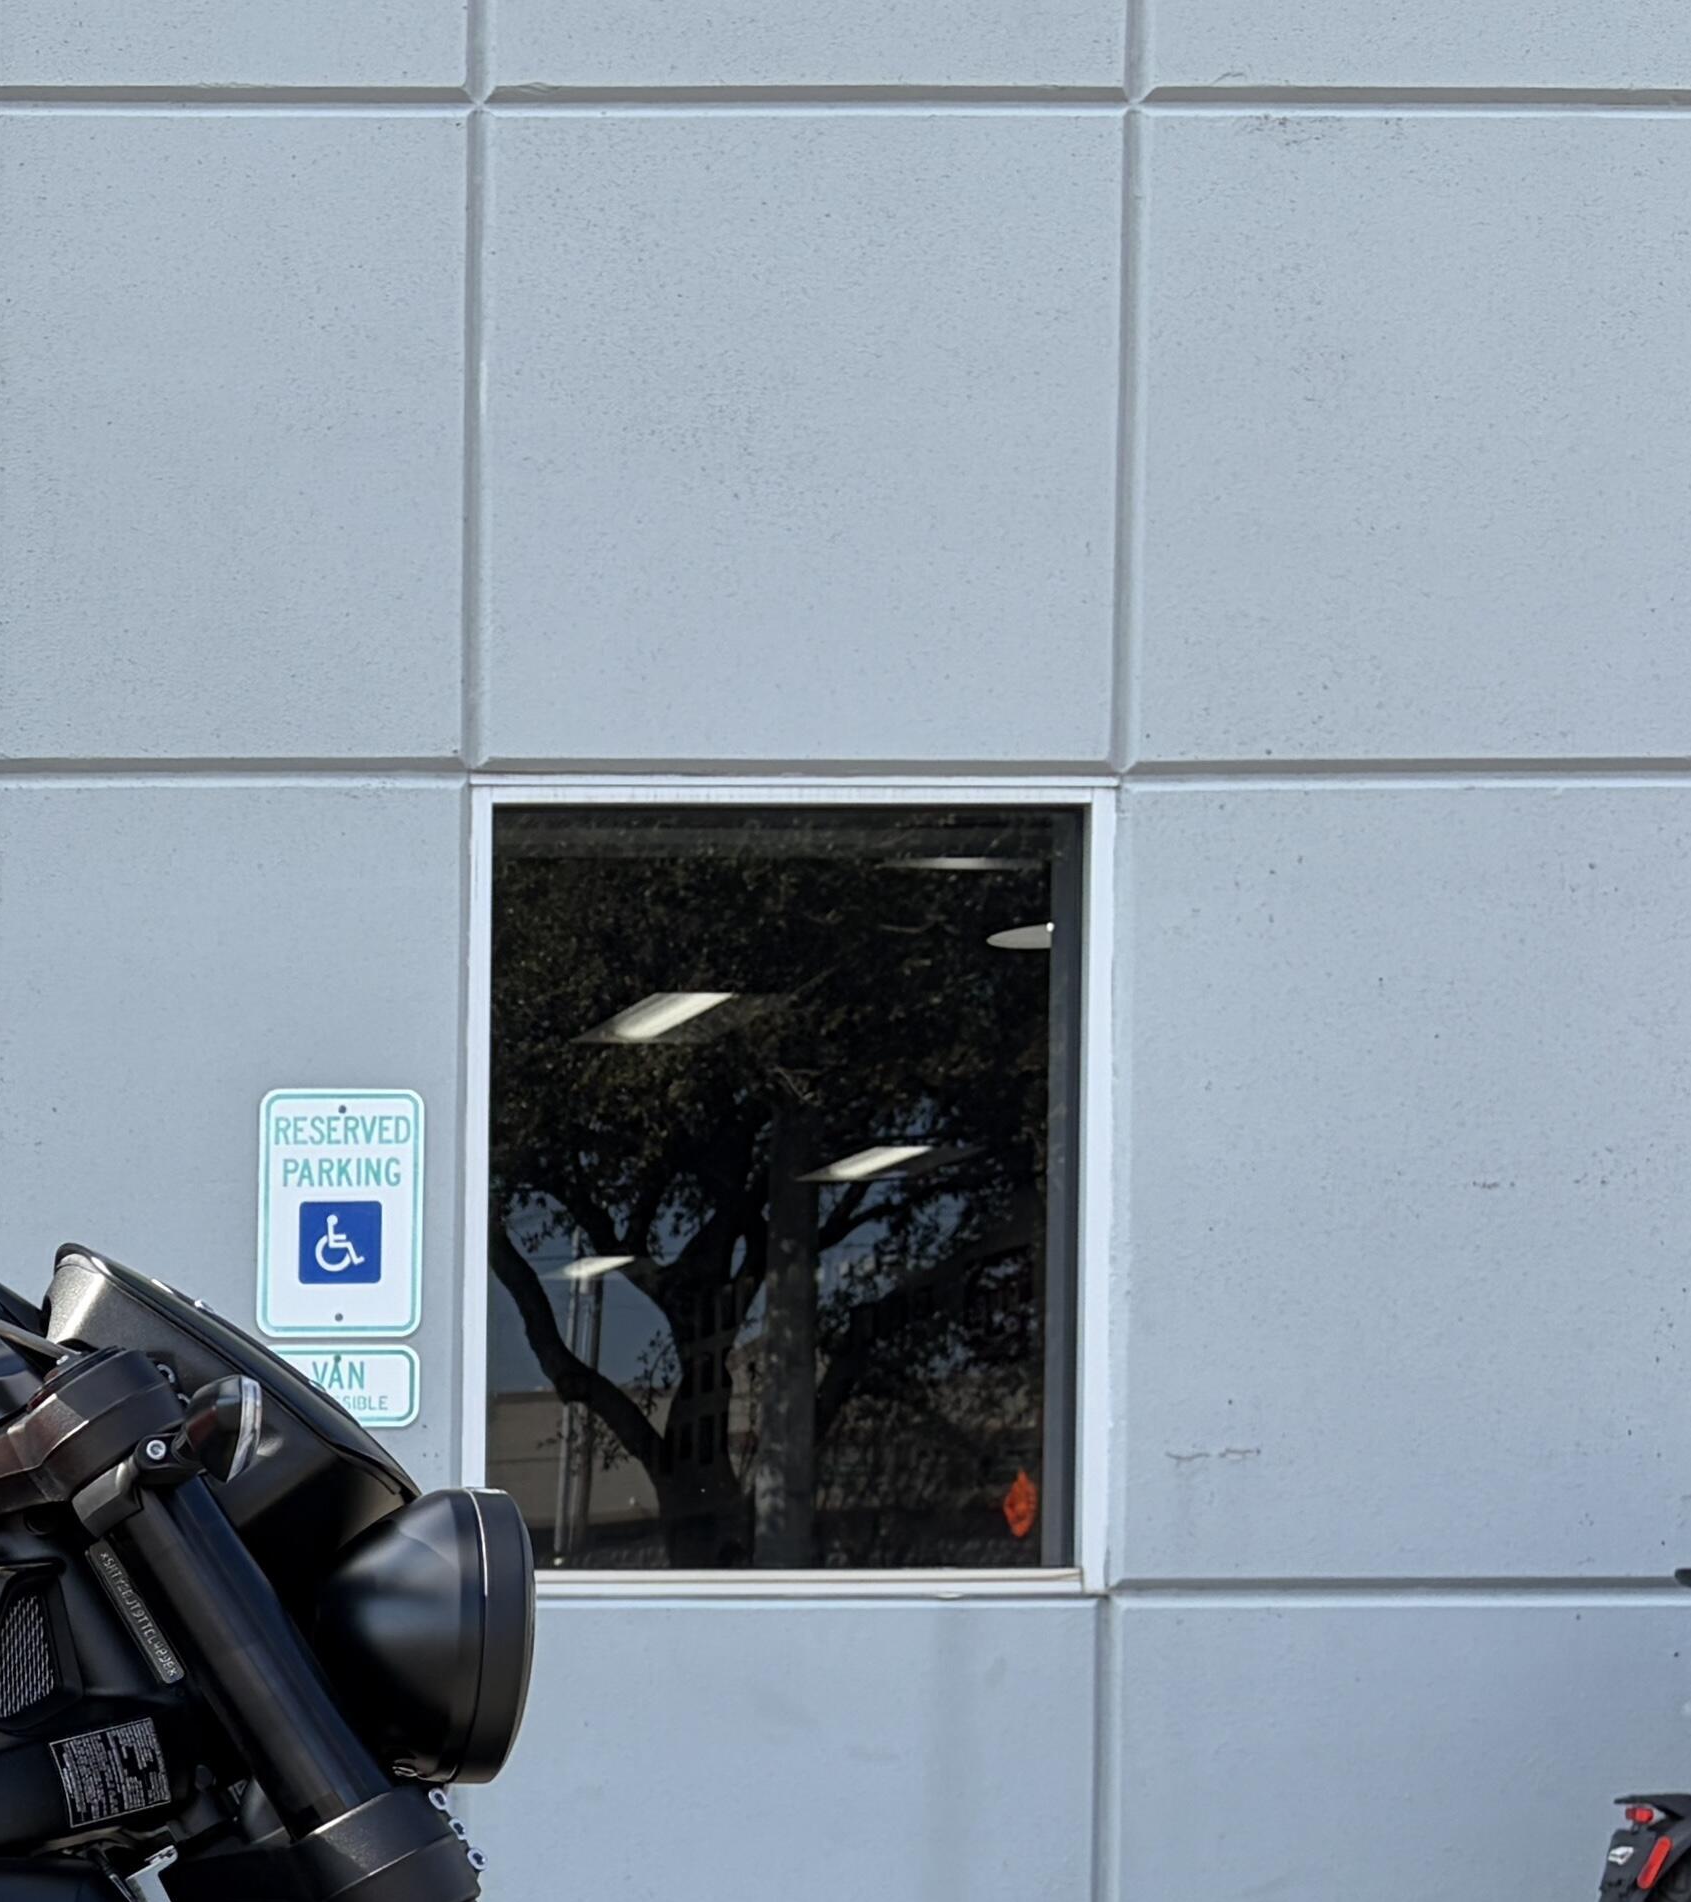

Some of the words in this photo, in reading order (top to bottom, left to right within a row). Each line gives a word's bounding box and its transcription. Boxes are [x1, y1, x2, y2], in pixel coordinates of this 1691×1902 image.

[273, 1115, 411, 1146] RESERVED
[282, 1157, 402, 1188] PARKING
[312, 1360, 365, 1390] VAN
